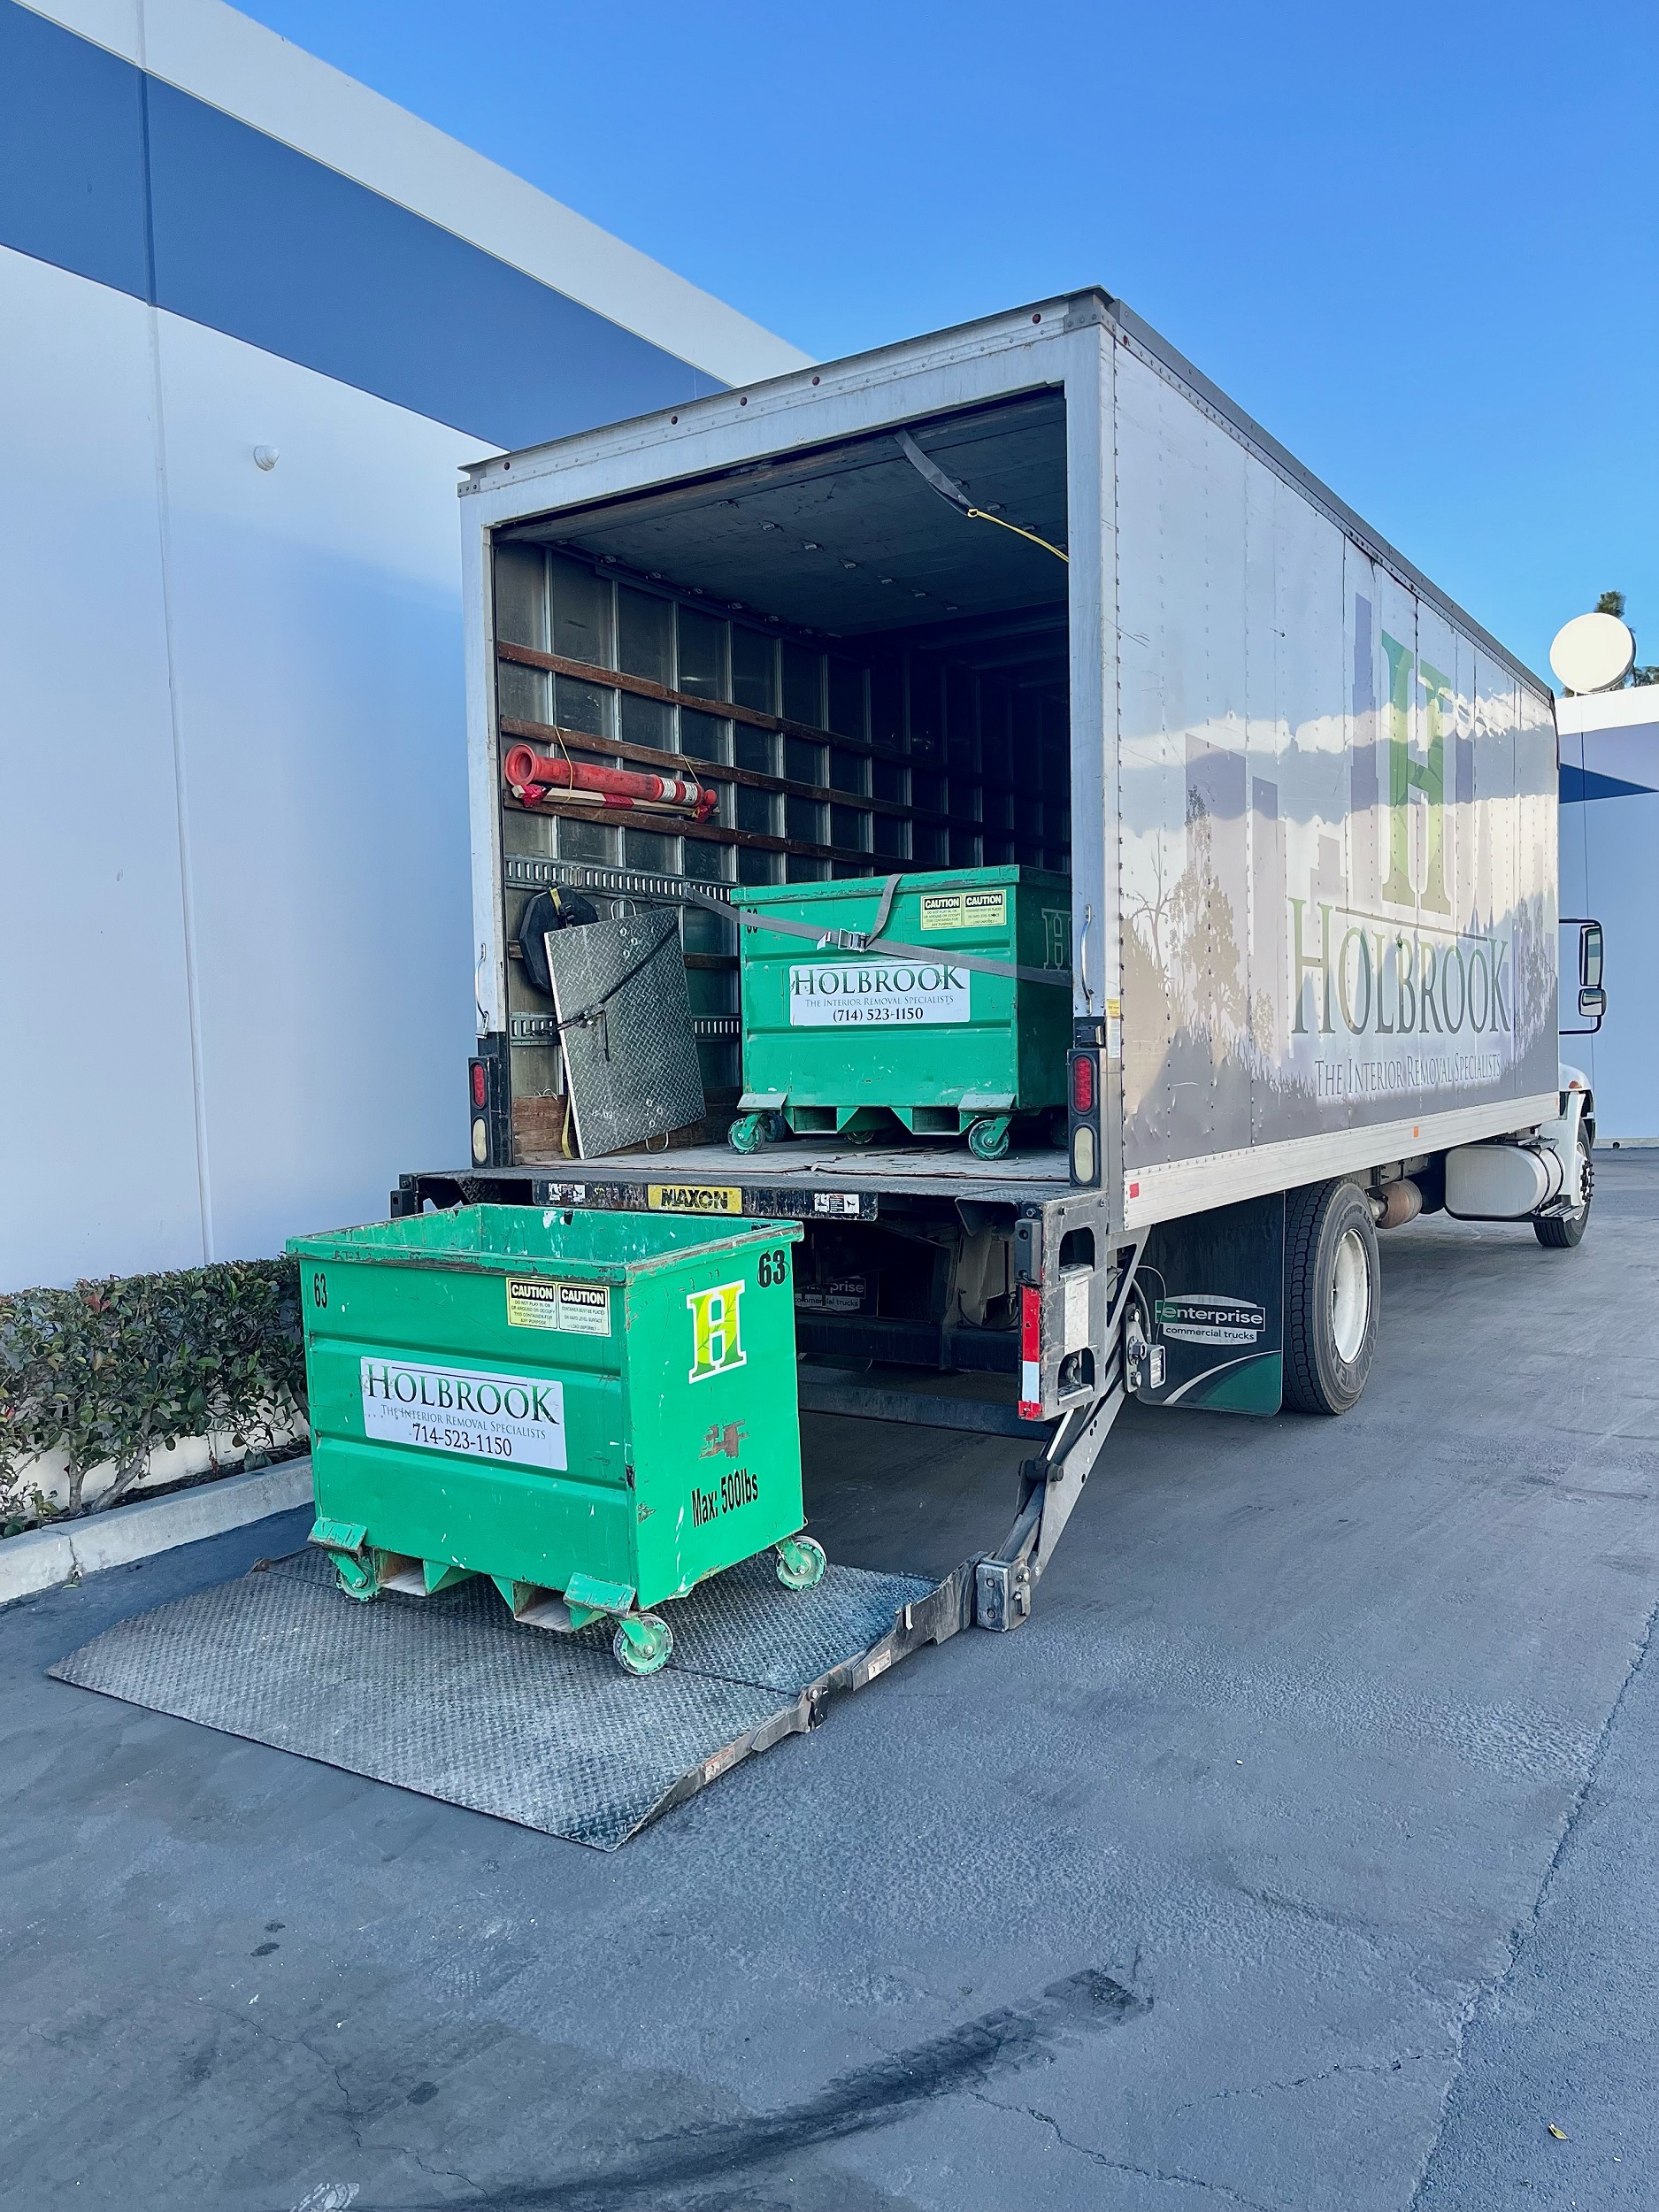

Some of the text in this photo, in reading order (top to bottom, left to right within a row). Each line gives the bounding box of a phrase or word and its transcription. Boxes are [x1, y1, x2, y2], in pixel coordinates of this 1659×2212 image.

[925, 898, 960, 909] CAUTION
[966, 895, 1002, 906] CAUTION
[793, 964, 967, 995] HOLBROOK
[1288, 897, 1511, 1035] HOLBROOK
[824, 998, 862, 1007] INTERIOR
[864, 996, 902, 1006] REMOVAL
[905, 995, 954, 1004] SPECIALISTS
[833, 1007, 924, 1023] (714) 523-1150
[1315, 1053, 1501, 1096] THE INTERIOR REMOVAL SPECIALISTS
[662, 1188, 727, 1209] MAXON
[758, 1249, 786, 1287] 63
[314, 1272, 327, 1309] 63
[511, 1284, 553, 1300] CAUTION
[561, 1289, 604, 1305] CAUTION
[687, 1279, 747, 1384] H
[1163, 1307, 1263, 1325] enterprise
[1166, 1327, 1255, 1340] commercial trucks
[366, 1363, 560, 1425] HOLBROOK
[381, 1404, 546, 1440] THE INTERIOR REMOVAL SPECIALISTS
[412, 1423, 512, 1456] 714-523-1150
[692, 1468, 758, 1528] Max: 500lbs
